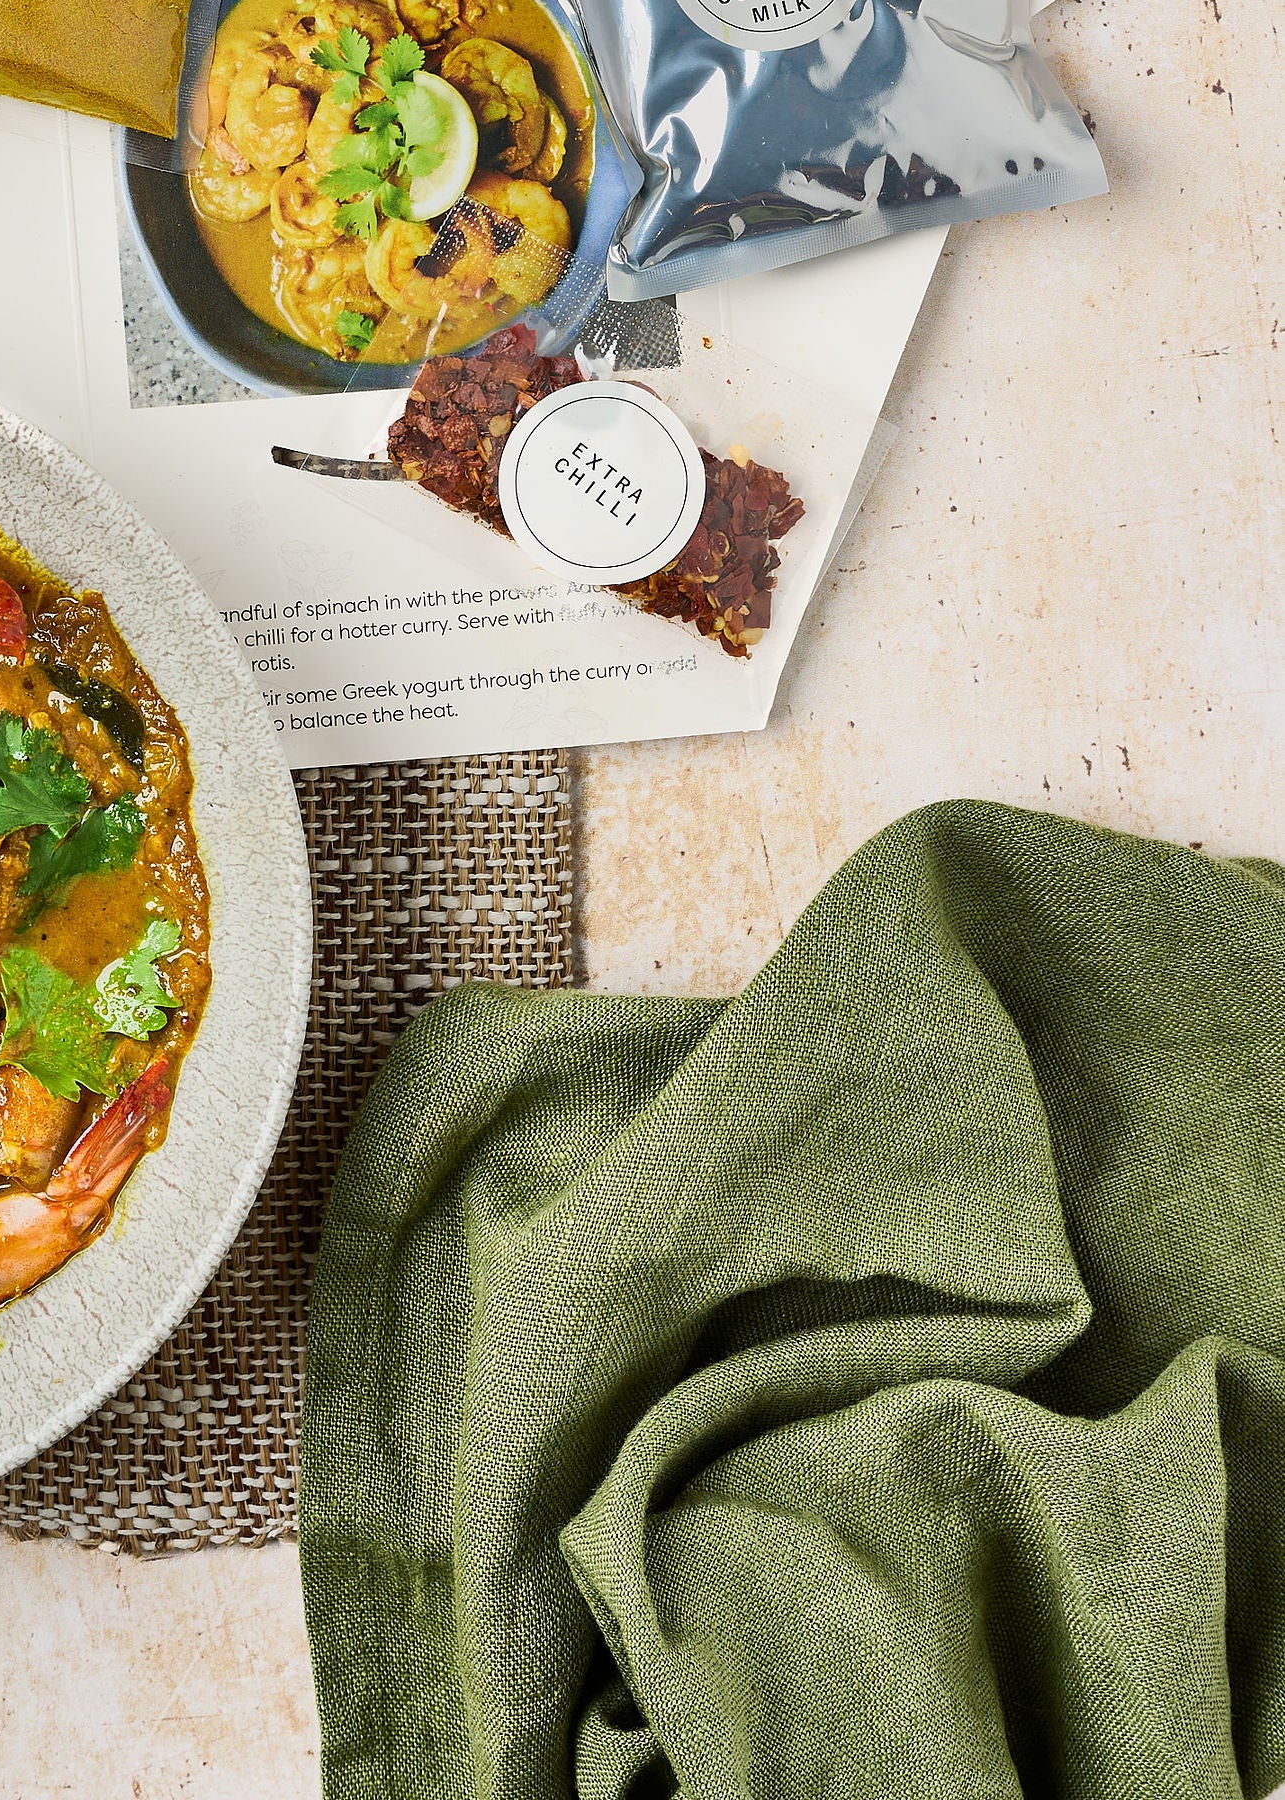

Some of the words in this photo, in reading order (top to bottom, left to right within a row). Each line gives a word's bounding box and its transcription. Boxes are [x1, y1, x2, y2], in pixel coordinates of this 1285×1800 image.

[554, 457, 637, 527] CHILLI
[571, 442, 643, 505] EXTRA
[282, 600, 303, 619] of
[306, 595, 379, 621] spinach
[384, 594, 401, 610] in
[405, 590, 447, 609] with
[451, 588, 484, 605] the
[244, 627, 285, 648] chilli
[290, 626, 317, 644] for
[320, 628, 333, 641] a
[339, 622, 398, 640] hotter
[401, 619, 452, 636] curry.
[457, 613, 509, 630] Serve
[513, 608, 554, 625] with
[251, 653, 295, 673] rotis.
[285, 688, 338, 705] some
[342, 680, 399, 700] Greek
[401, 676, 465, 700] yogurt
[468, 668, 544, 690] through
[548, 666, 581, 683] the
[585, 664, 632, 681] curry
[290, 711, 368, 731] balance
[372, 706, 405, 724] the
[409, 702, 459, 721] heat.
